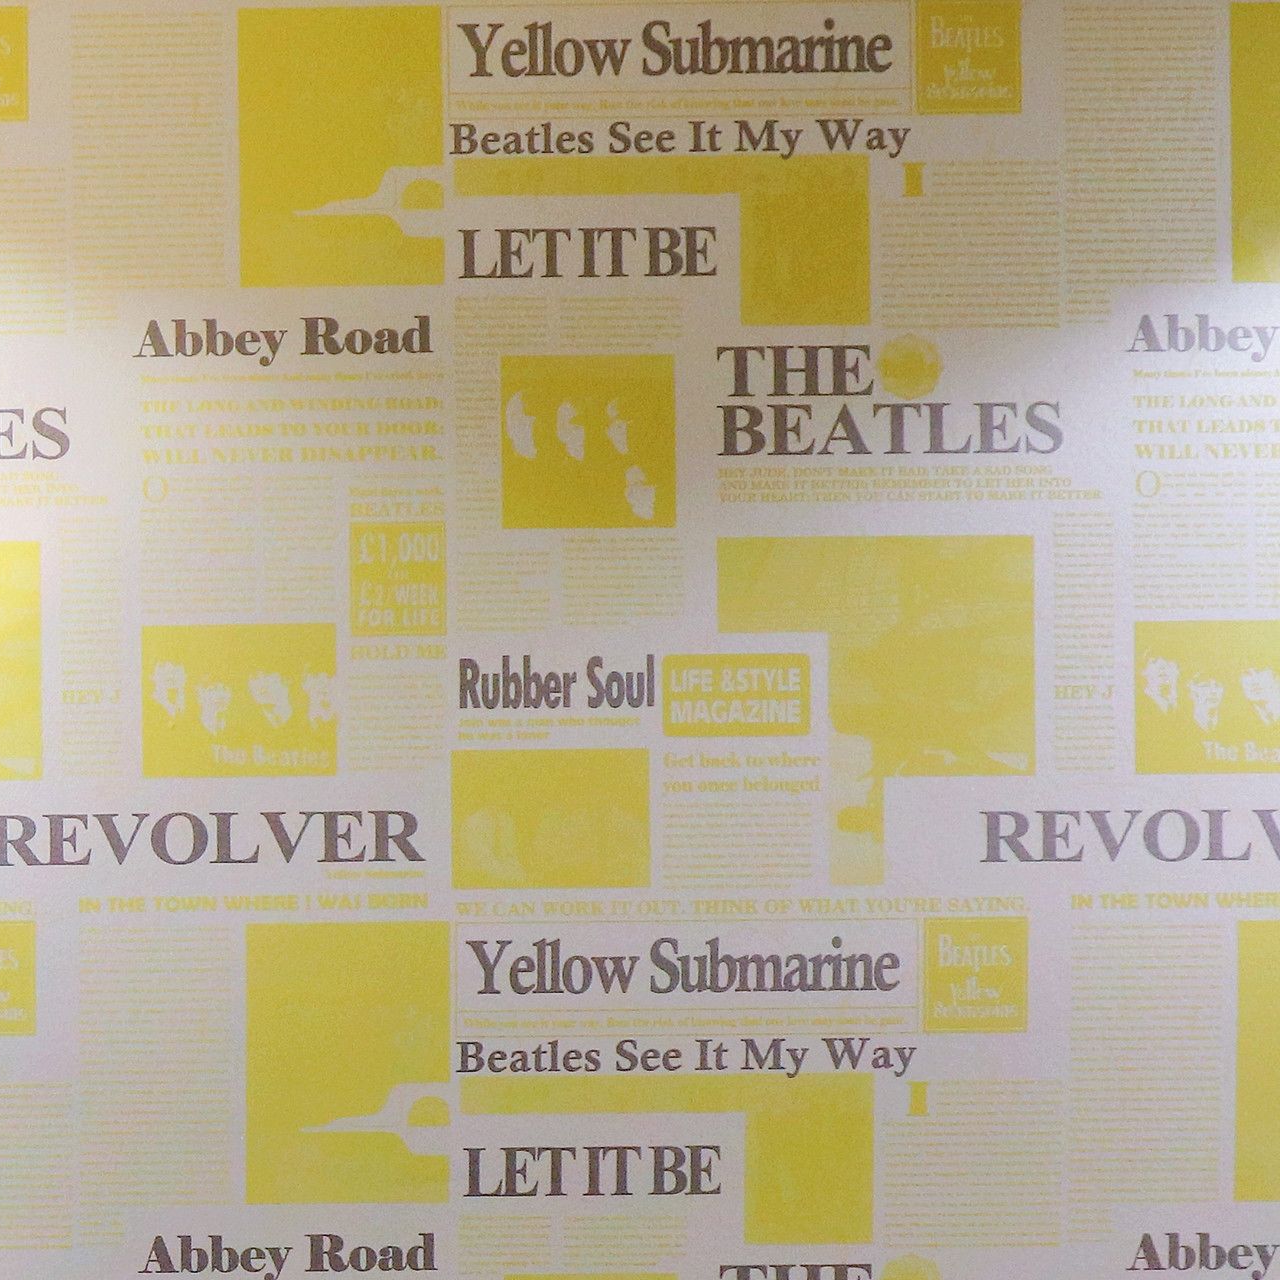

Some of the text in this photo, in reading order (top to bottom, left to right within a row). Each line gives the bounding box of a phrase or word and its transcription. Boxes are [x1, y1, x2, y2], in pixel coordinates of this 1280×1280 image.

[457, 18, 892, 78] Yellow Submarine
[450, 119, 911, 160] Beatles See It My Way
[459, 227, 717, 279] LET IT BE
[136, 315, 433, 367] Abbey Road
[1124, 312, 1280, 362] Abbey
[717, 345, 874, 397] THE
[716, 400, 1064, 457] BEATLES
[459, 654, 654, 710] Rubber Soul
[466, 936, 899, 995] Yellow Submarine
[456, 1037, 917, 1078] Beatles See It My Way
[463, 1145, 721, 1197] LET IT BE
[305, 1233, 437, 1272] Road
[1126, 1232, 1280, 1280] Abbey
